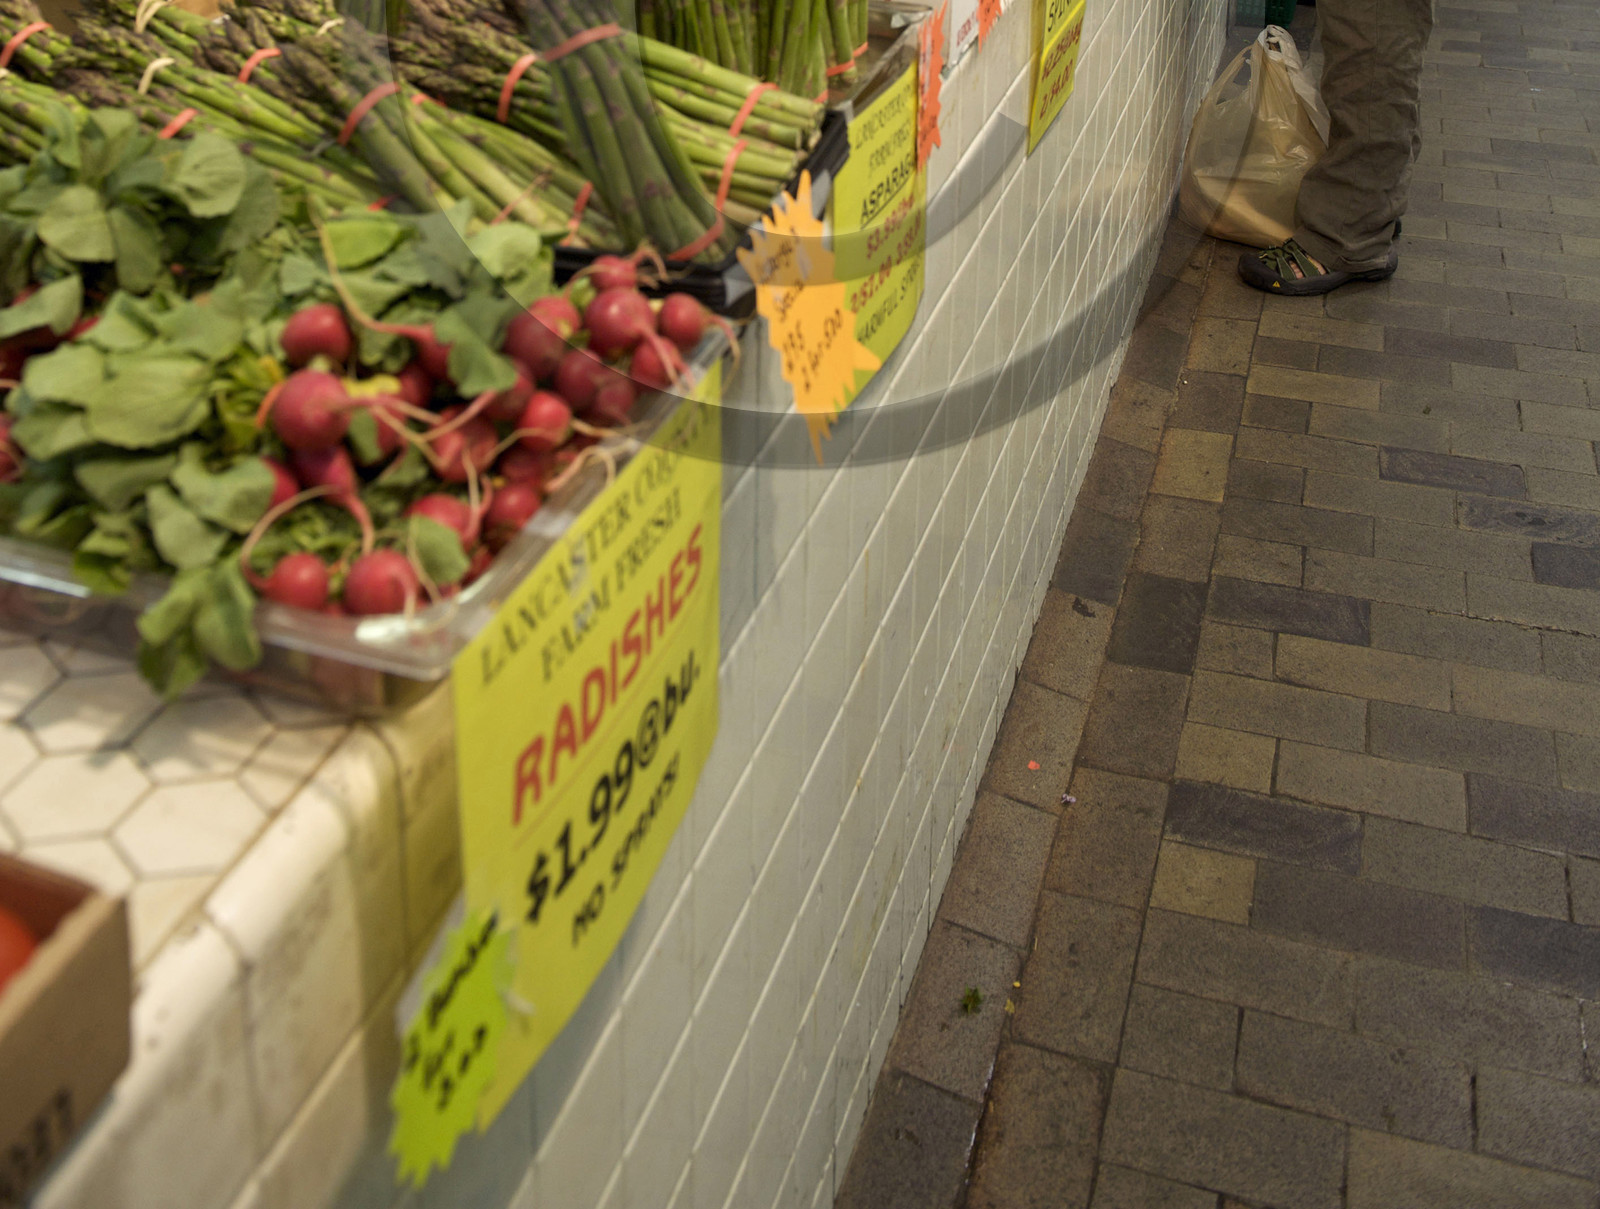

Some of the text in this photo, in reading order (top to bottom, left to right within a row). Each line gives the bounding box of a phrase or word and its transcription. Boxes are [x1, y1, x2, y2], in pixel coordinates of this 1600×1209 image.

[480, 489, 632, 686] LANCASTER
[511, 522, 703, 828] RADISHES
[541, 487, 682, 683] FARM FRESH
[571, 882, 605, 949] NO
